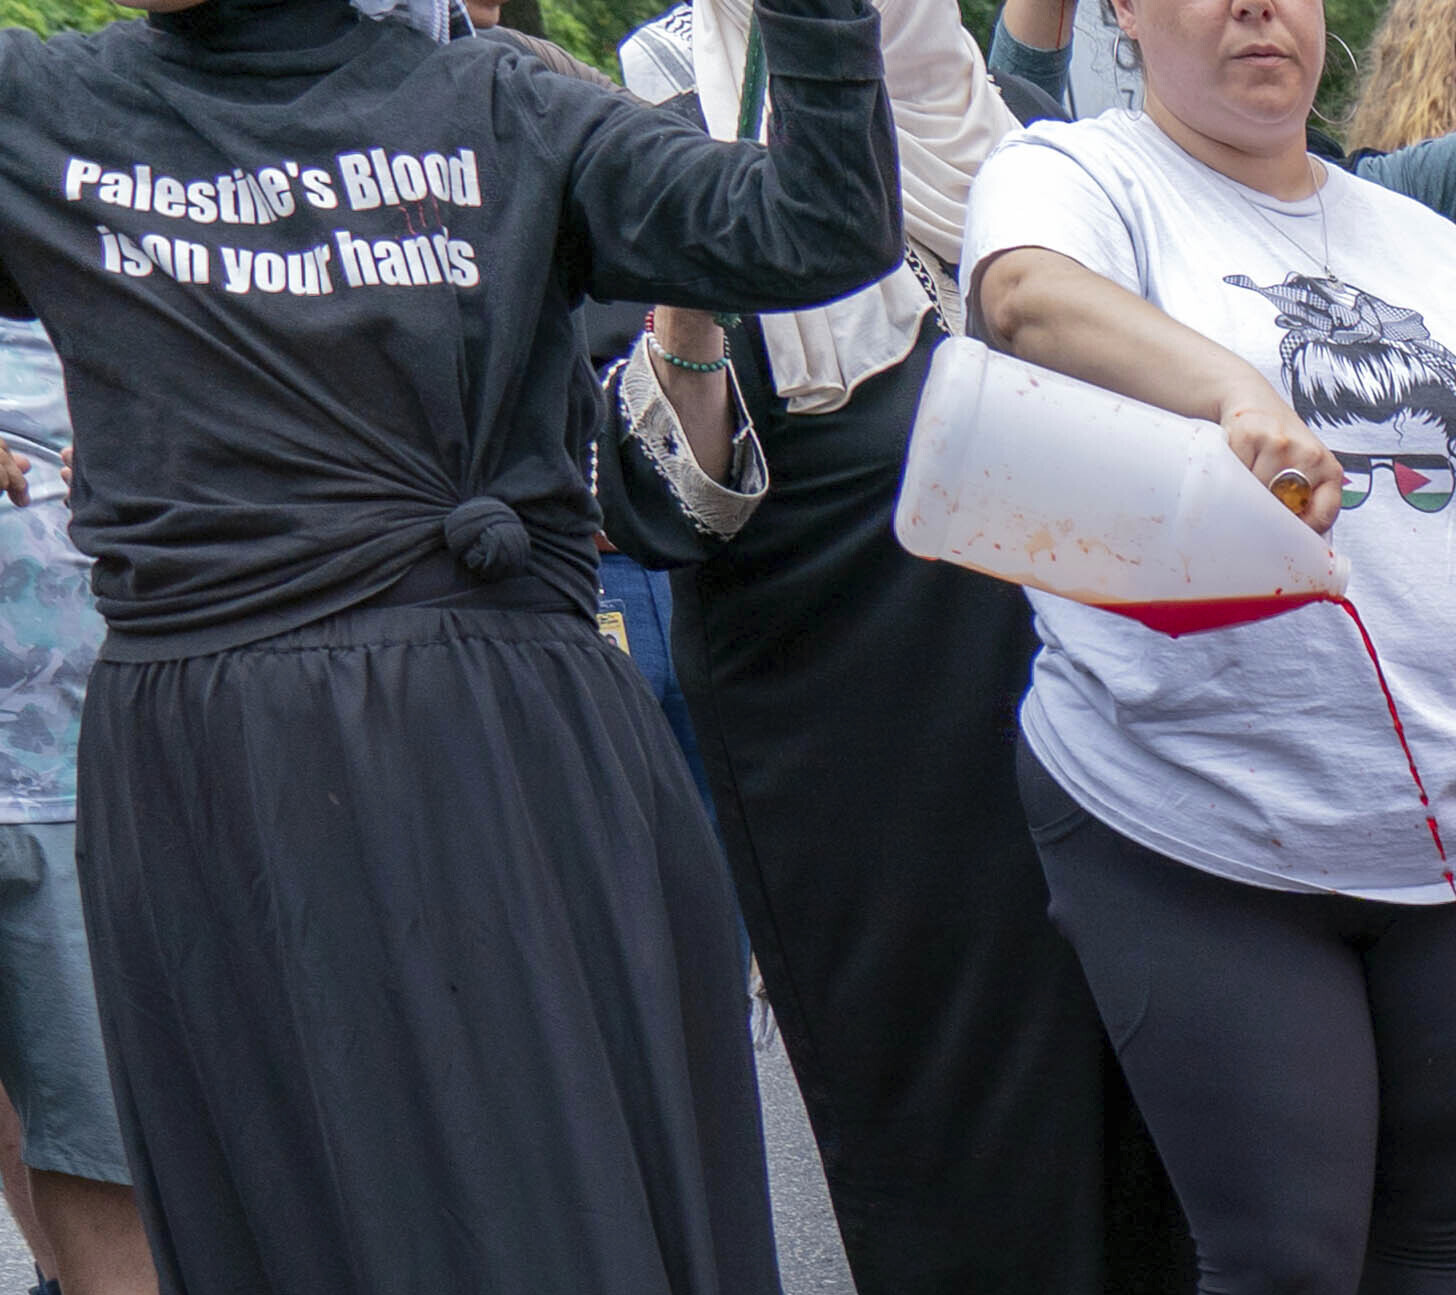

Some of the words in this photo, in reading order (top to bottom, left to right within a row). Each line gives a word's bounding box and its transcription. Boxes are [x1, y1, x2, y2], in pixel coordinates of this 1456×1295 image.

[64, 156, 338, 225] Palestine's
[336, 147, 482, 211] Blood
[97, 226, 153, 278] is
[141, 233, 210, 284] on
[220, 244, 334, 296] your
